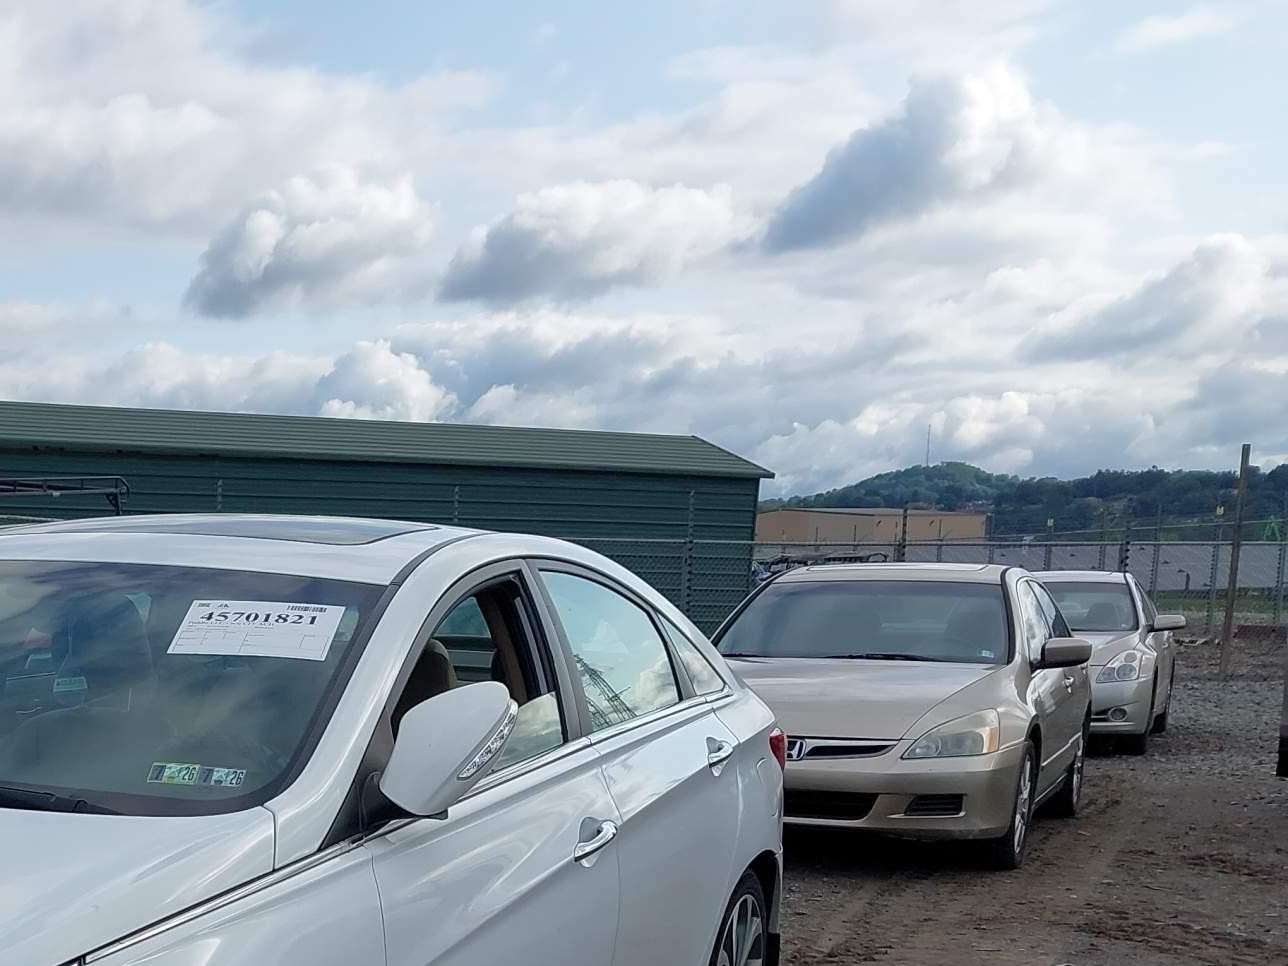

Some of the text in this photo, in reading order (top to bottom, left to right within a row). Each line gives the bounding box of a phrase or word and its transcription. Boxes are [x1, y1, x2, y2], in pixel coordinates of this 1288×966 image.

[200, 611, 318, 626] 45701821
[154, 766, 196, 781] 7 26
[202, 768, 244, 785] 7 26
